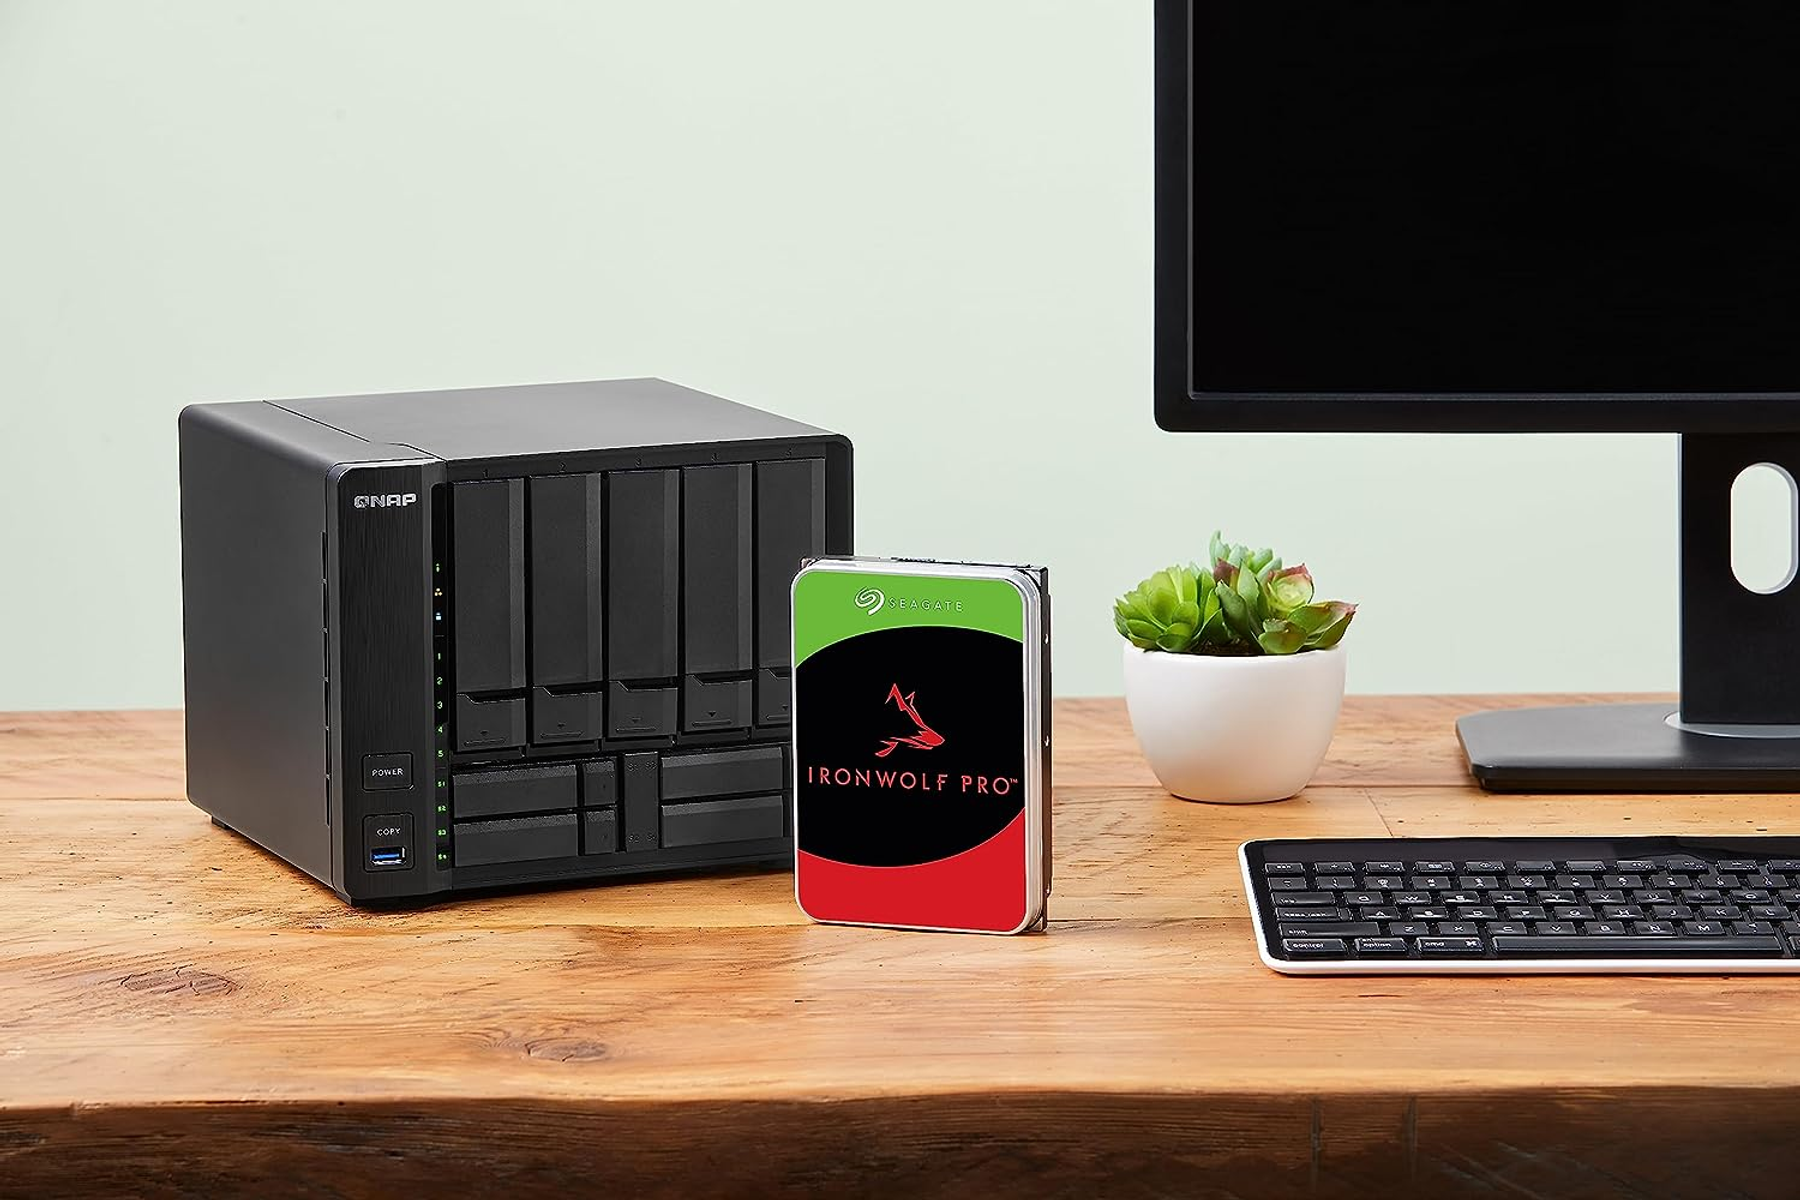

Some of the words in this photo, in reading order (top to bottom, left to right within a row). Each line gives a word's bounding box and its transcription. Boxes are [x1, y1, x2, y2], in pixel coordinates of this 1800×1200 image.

[353, 493, 417, 508] QNAP
[888, 597, 964, 612] SEAGATE
[436, 676, 443, 685] 2
[436, 700, 443, 709] 3
[437, 749, 444, 758] 5
[371, 767, 405, 777] POWER
[808, 766, 948, 791] IRONWOLF
[376, 827, 401, 837] COPY
